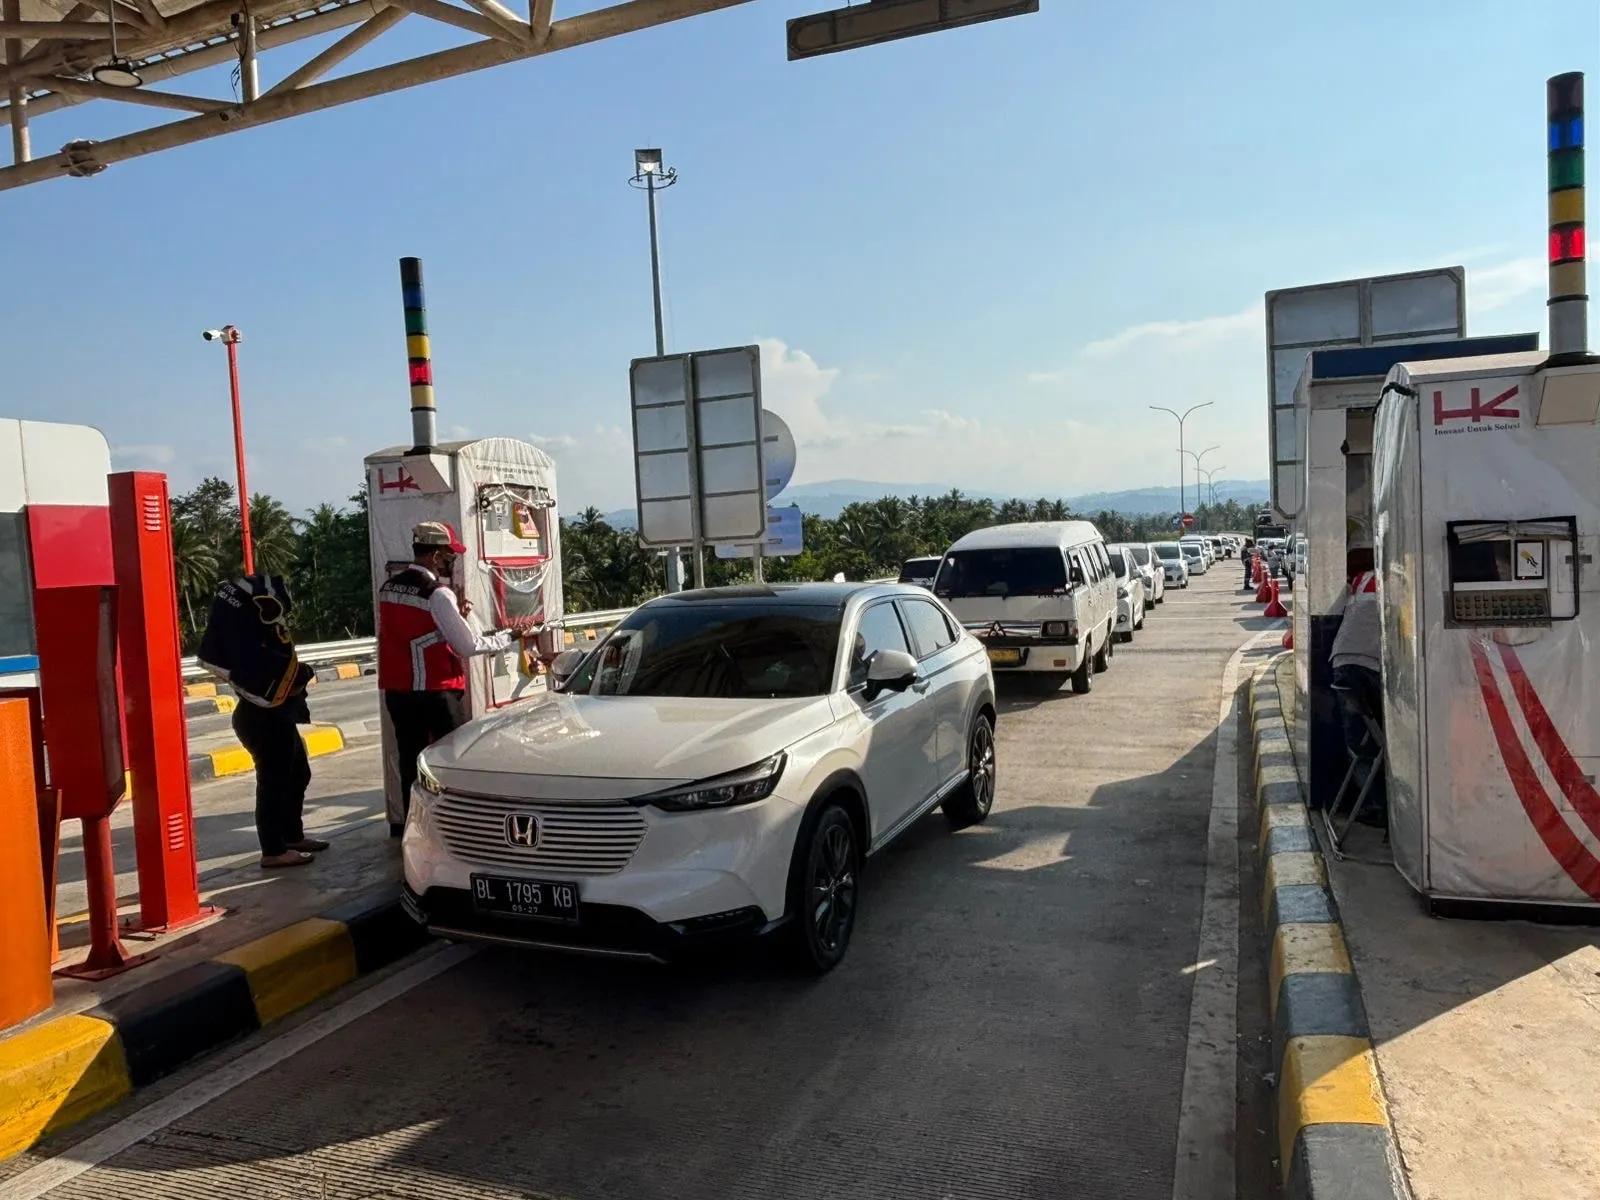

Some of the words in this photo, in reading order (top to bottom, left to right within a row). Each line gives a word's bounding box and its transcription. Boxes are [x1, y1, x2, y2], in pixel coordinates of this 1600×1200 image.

[1433, 384, 1520, 425] HK
[1434, 427, 1464, 436] Inovasi
[1467, 424, 1493, 433] Untuk
[1494, 421, 1520, 431] Solusi
[475, 878, 497, 900] BL
[506, 881, 543, 904] 1795
[552, 885, 573, 908] KB
